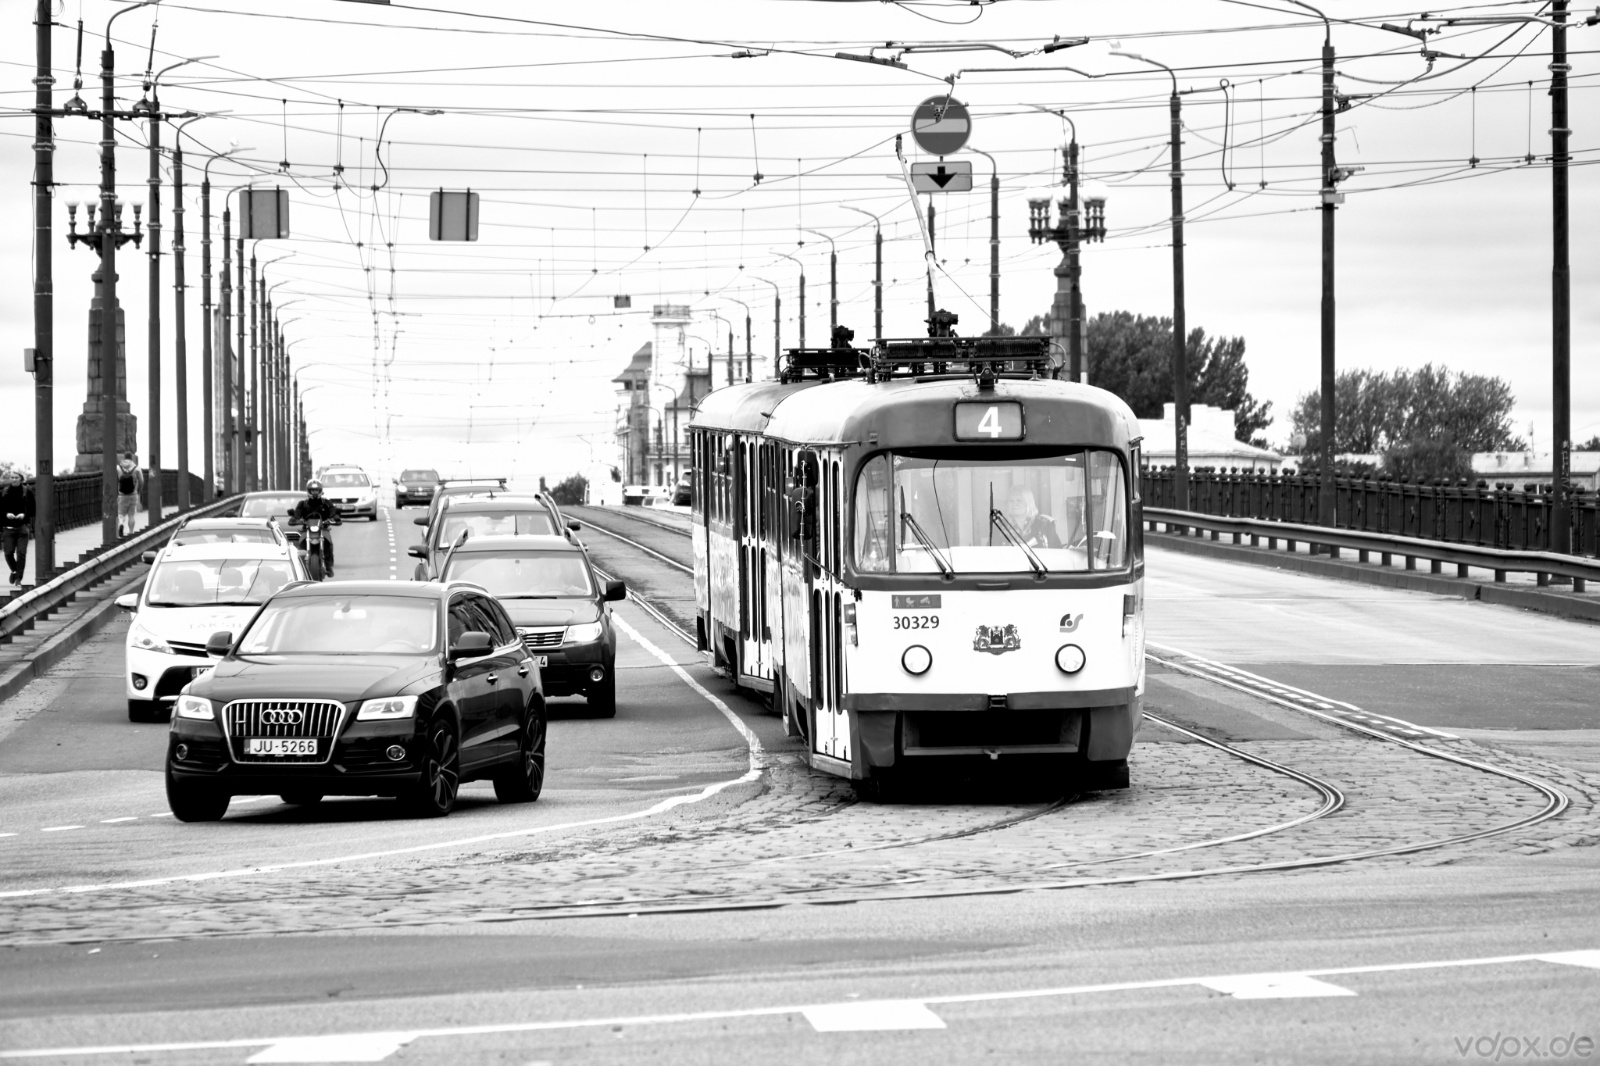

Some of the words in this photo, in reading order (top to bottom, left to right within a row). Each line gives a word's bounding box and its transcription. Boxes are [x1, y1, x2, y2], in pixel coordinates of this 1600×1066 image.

[977, 406, 1003, 438] 4
[893, 615, 940, 630] 30329
[253, 740, 315, 753] JU-5266
